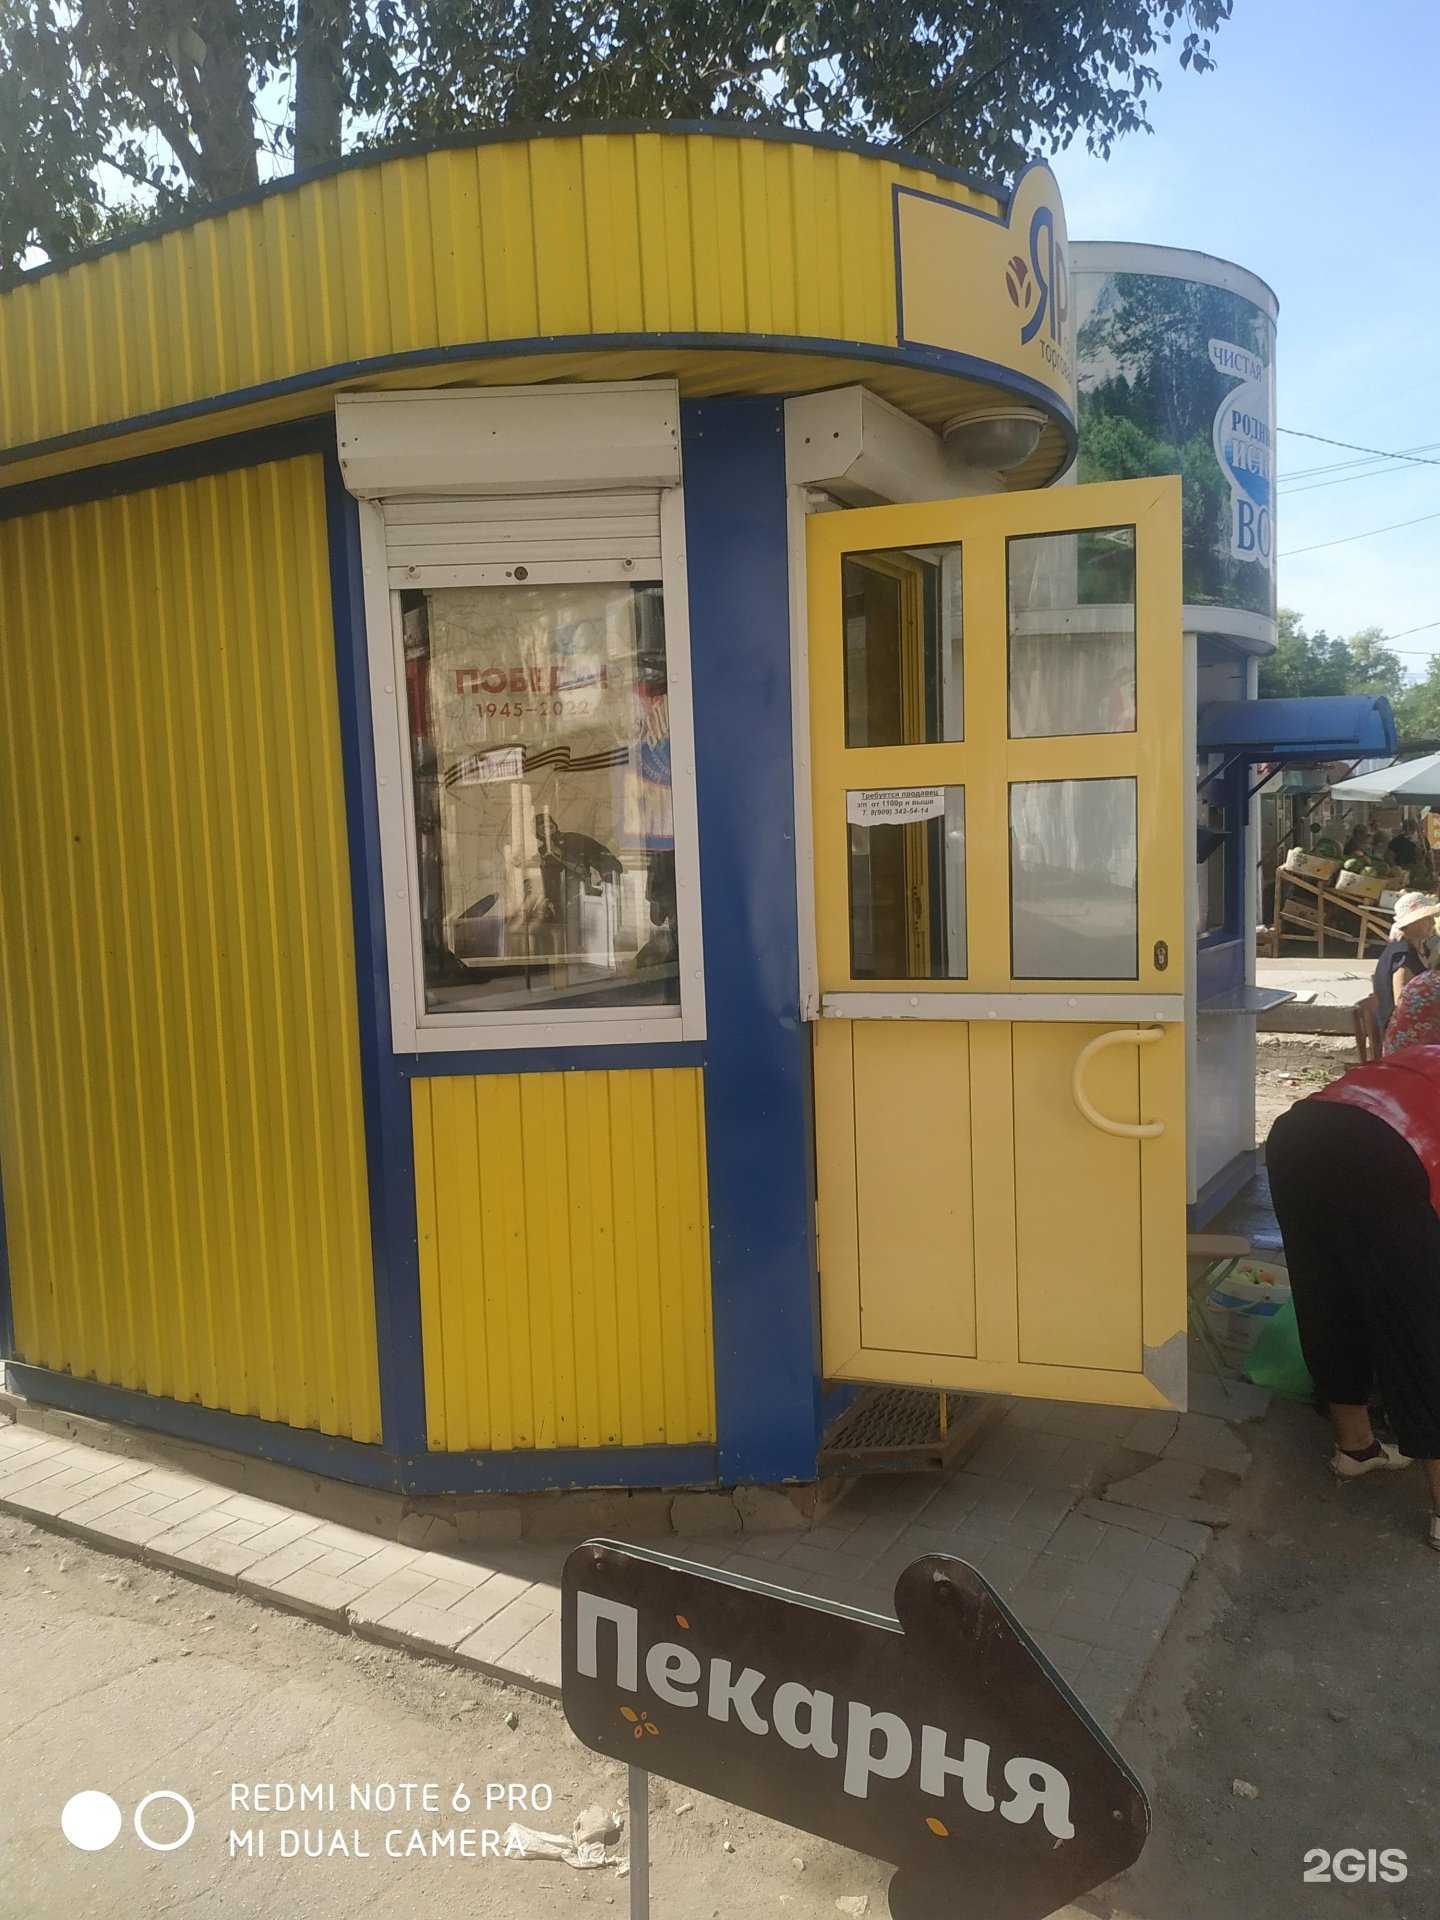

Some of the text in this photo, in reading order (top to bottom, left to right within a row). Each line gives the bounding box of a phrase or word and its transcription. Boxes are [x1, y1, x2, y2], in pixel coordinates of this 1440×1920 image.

[1214, 346, 1263, 384] ЧИСТАЯ
[862, 790, 938, 800] Требуется продавец
[577, 1590, 1075, 1839] Пекарня
